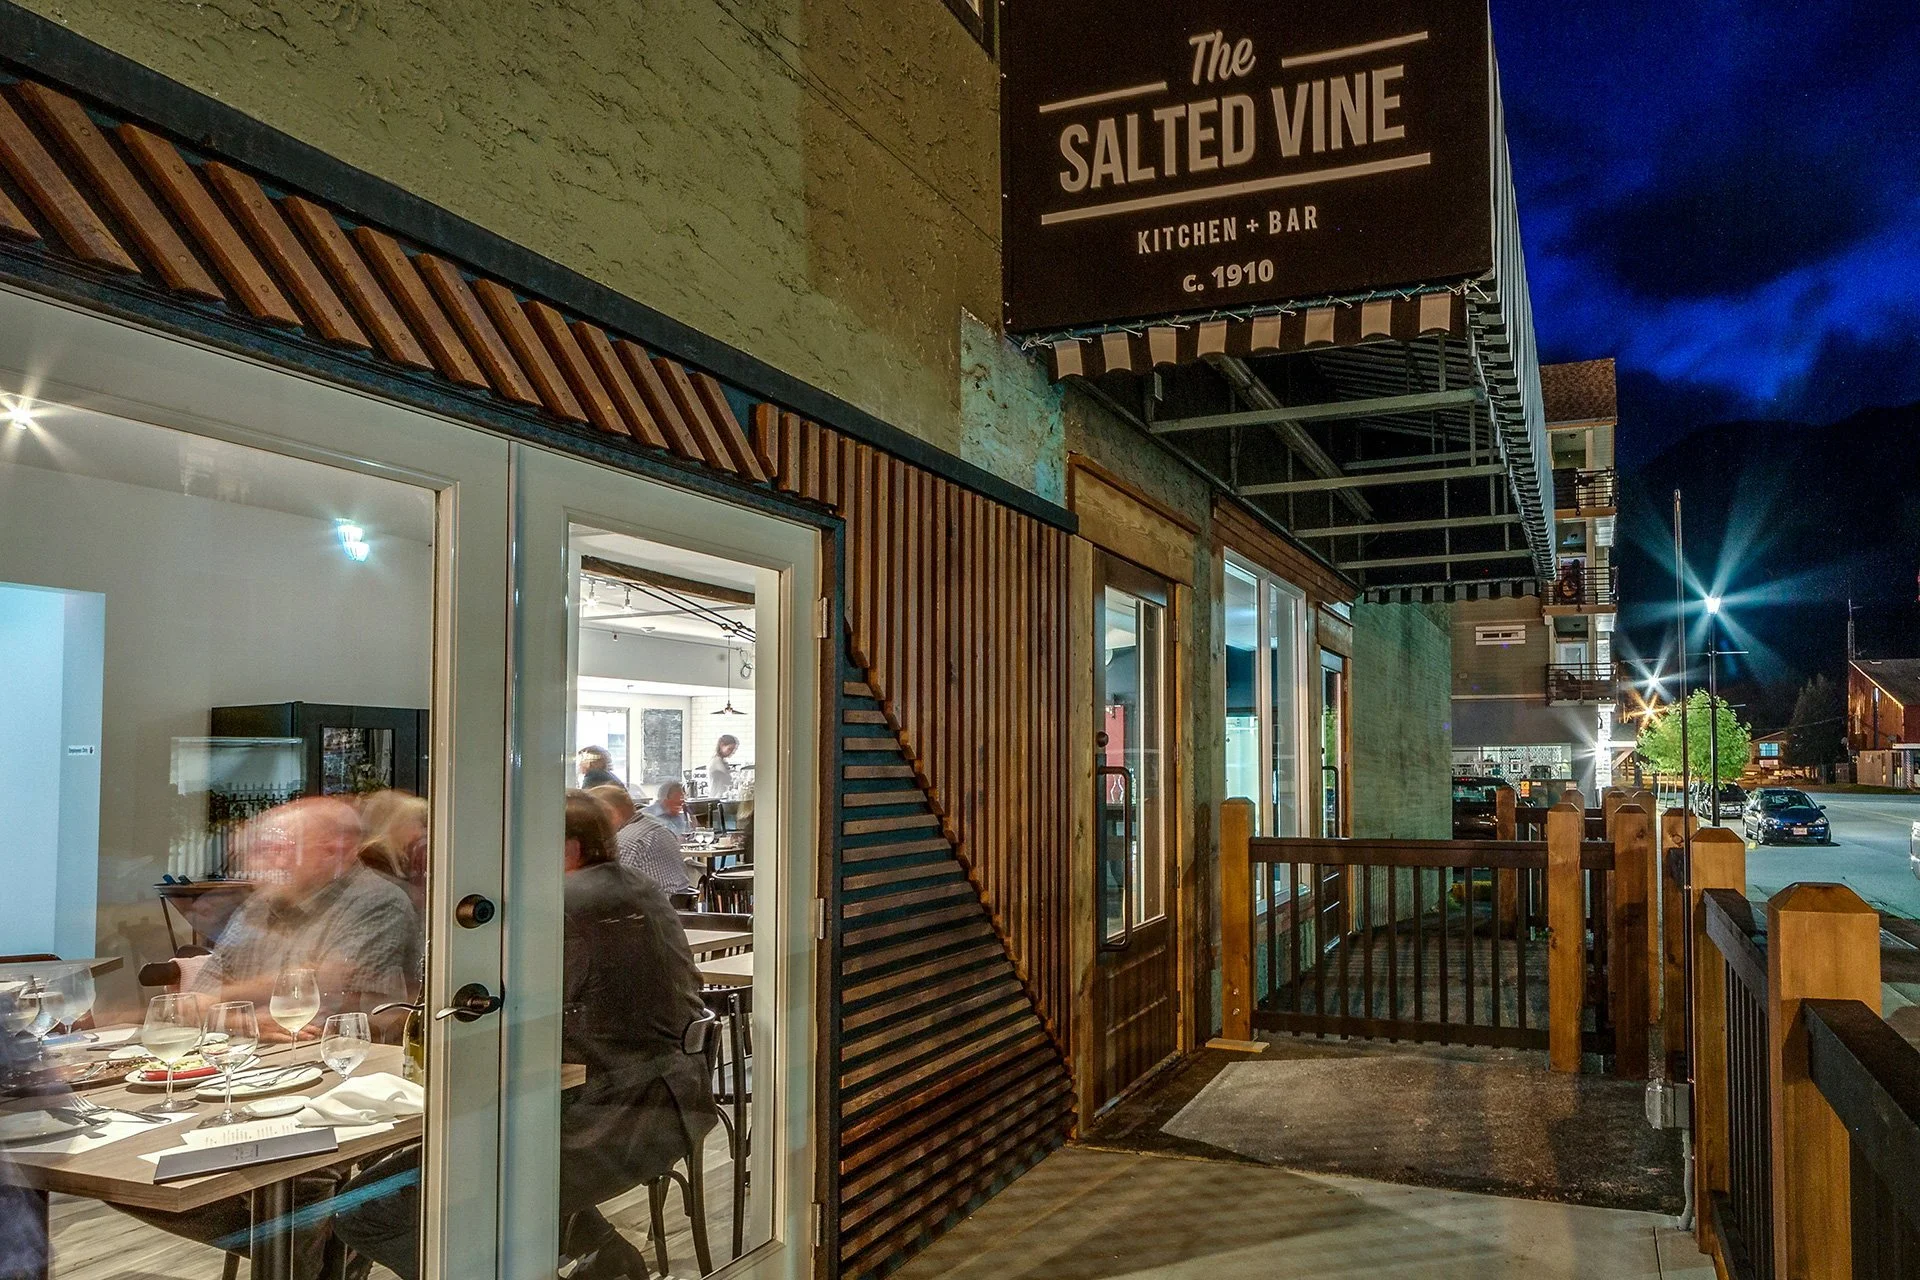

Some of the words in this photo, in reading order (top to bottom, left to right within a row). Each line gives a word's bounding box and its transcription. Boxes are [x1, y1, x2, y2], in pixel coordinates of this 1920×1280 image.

[1189, 29, 1256, 85] The
[1060, 95, 1256, 192] SALTED
[1271, 65, 1405, 157] VINE
[1138, 217, 1237, 254] KITCHEN
[1246, 218, 1259, 233] +
[1269, 206, 1318, 235] BAR
[1182, 274, 1205, 293] c.
[1211, 259, 1274, 289] 1910
